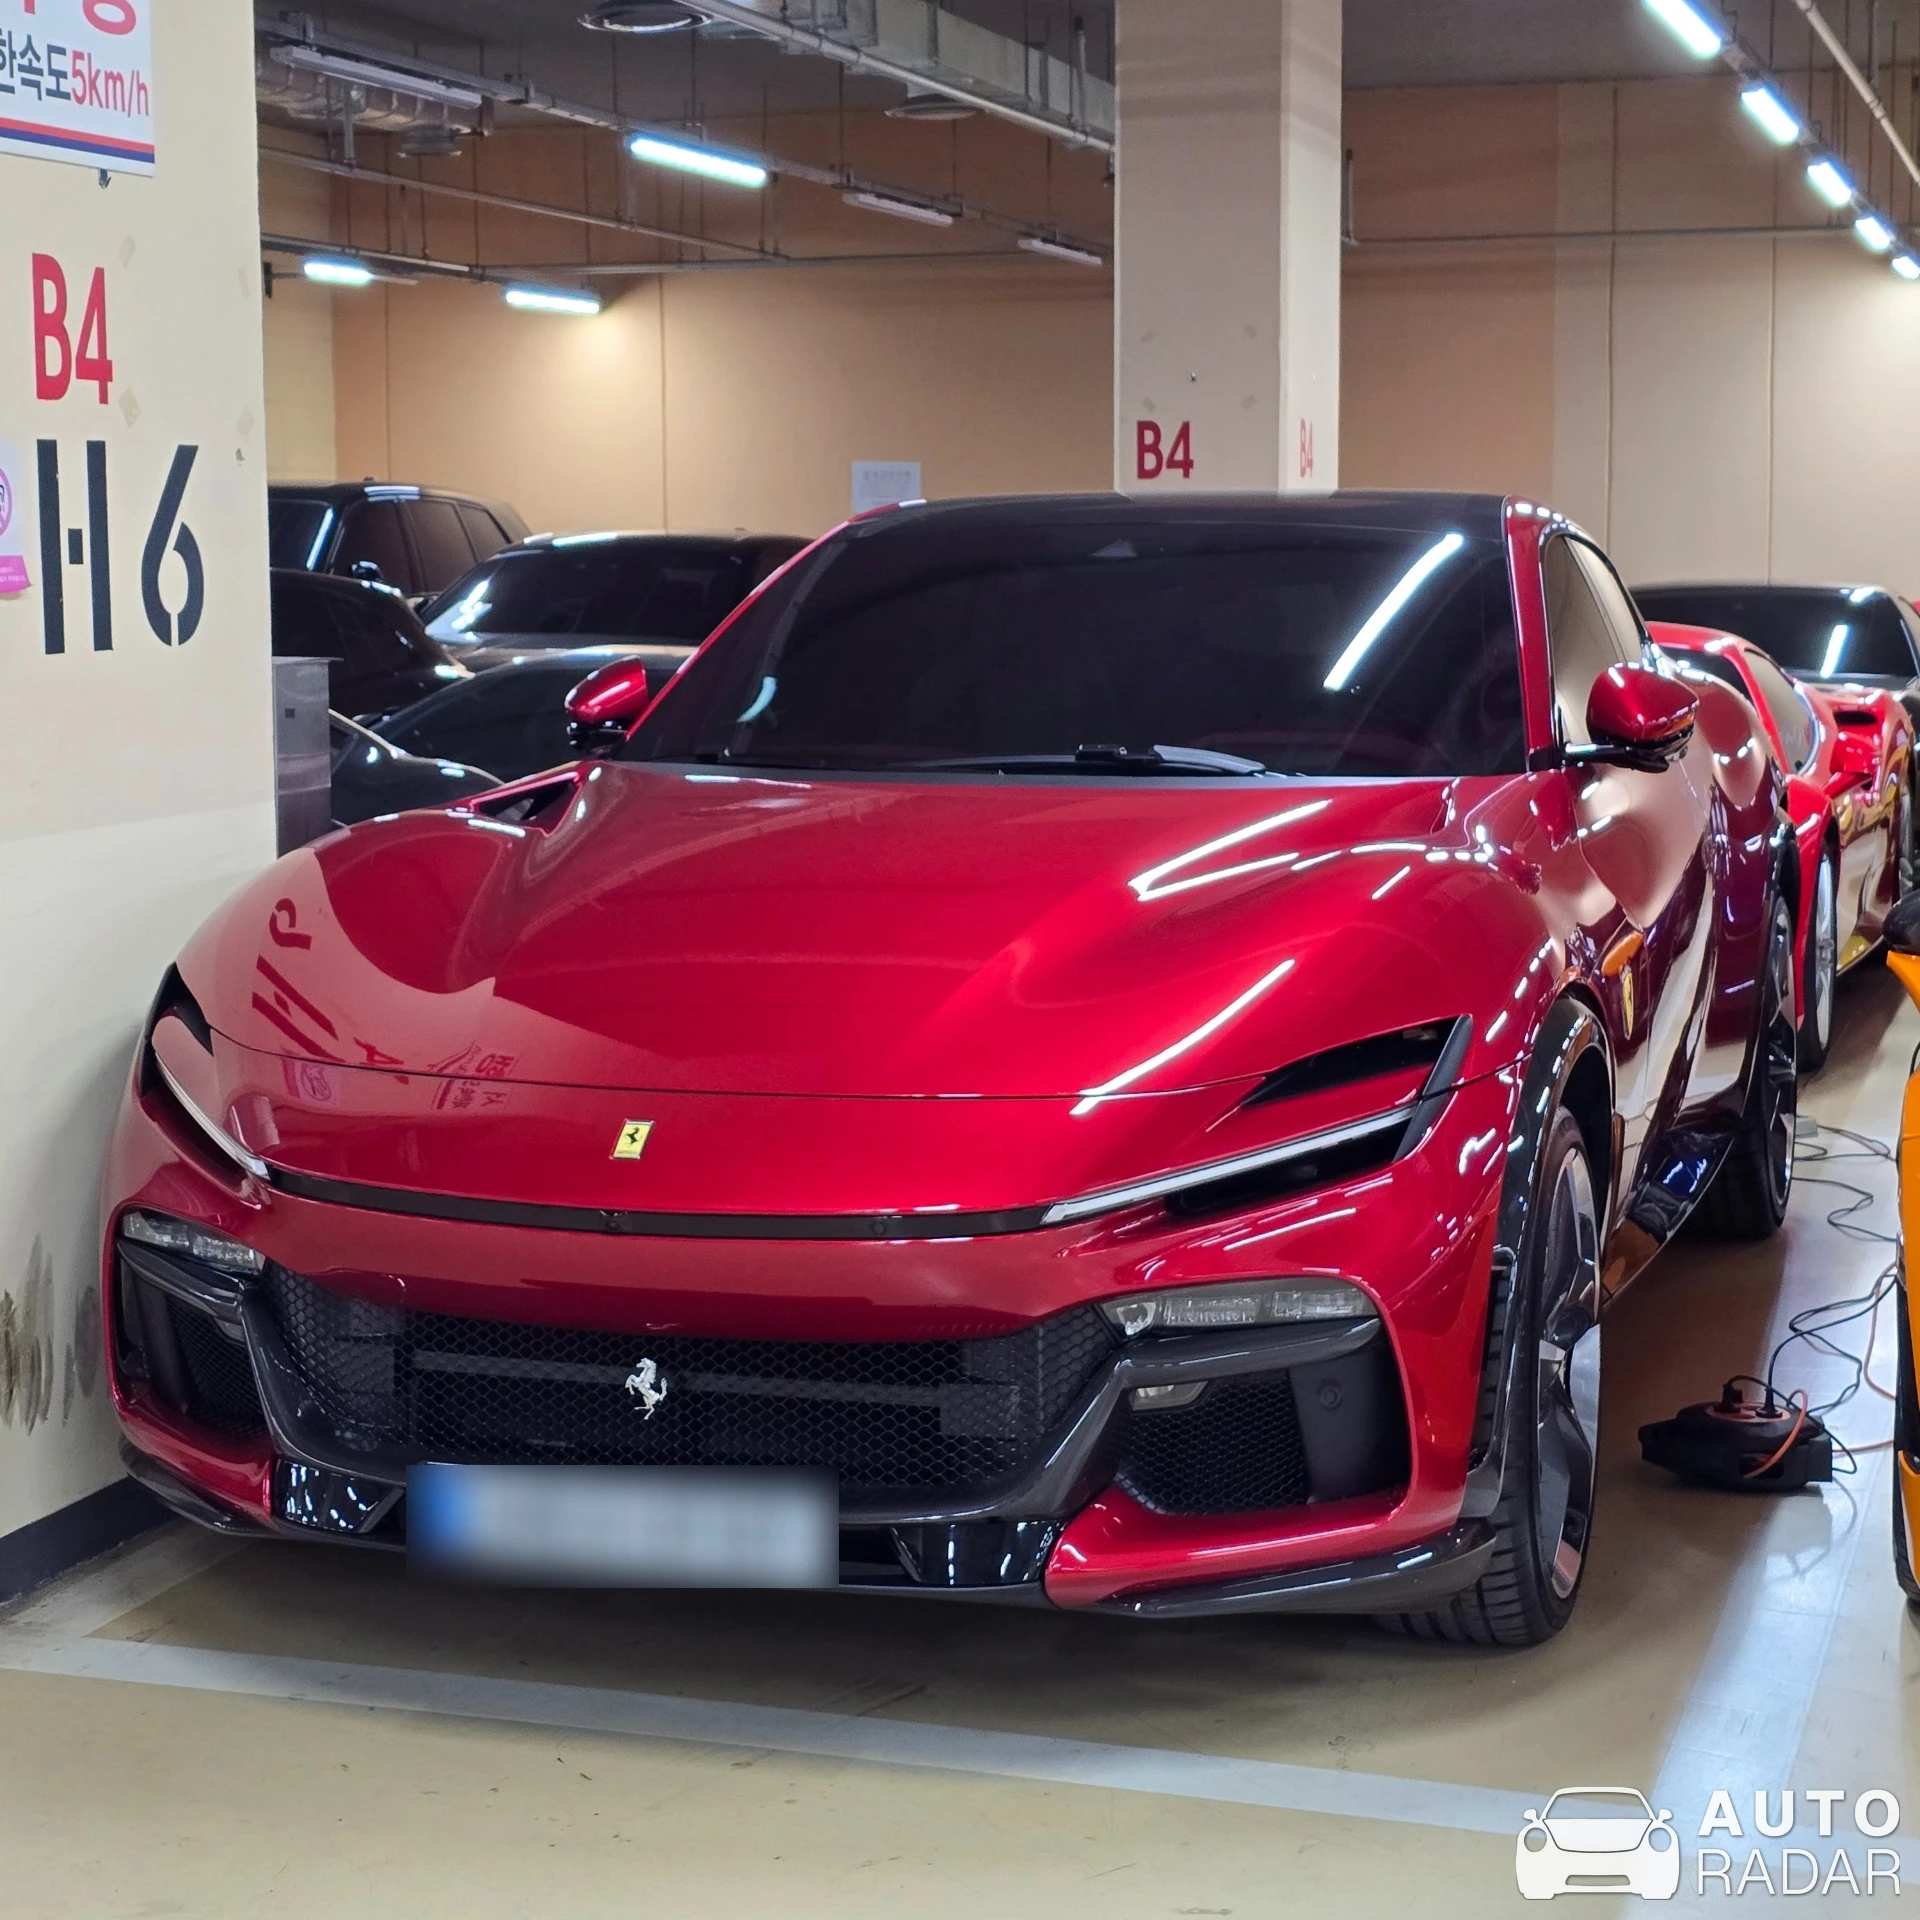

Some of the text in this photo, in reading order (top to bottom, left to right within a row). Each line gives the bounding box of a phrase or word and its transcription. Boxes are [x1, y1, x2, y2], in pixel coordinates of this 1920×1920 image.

[32, 253, 113, 405] B4
[1137, 420, 1194, 479] B4
[1300, 418, 1313, 478] B4
